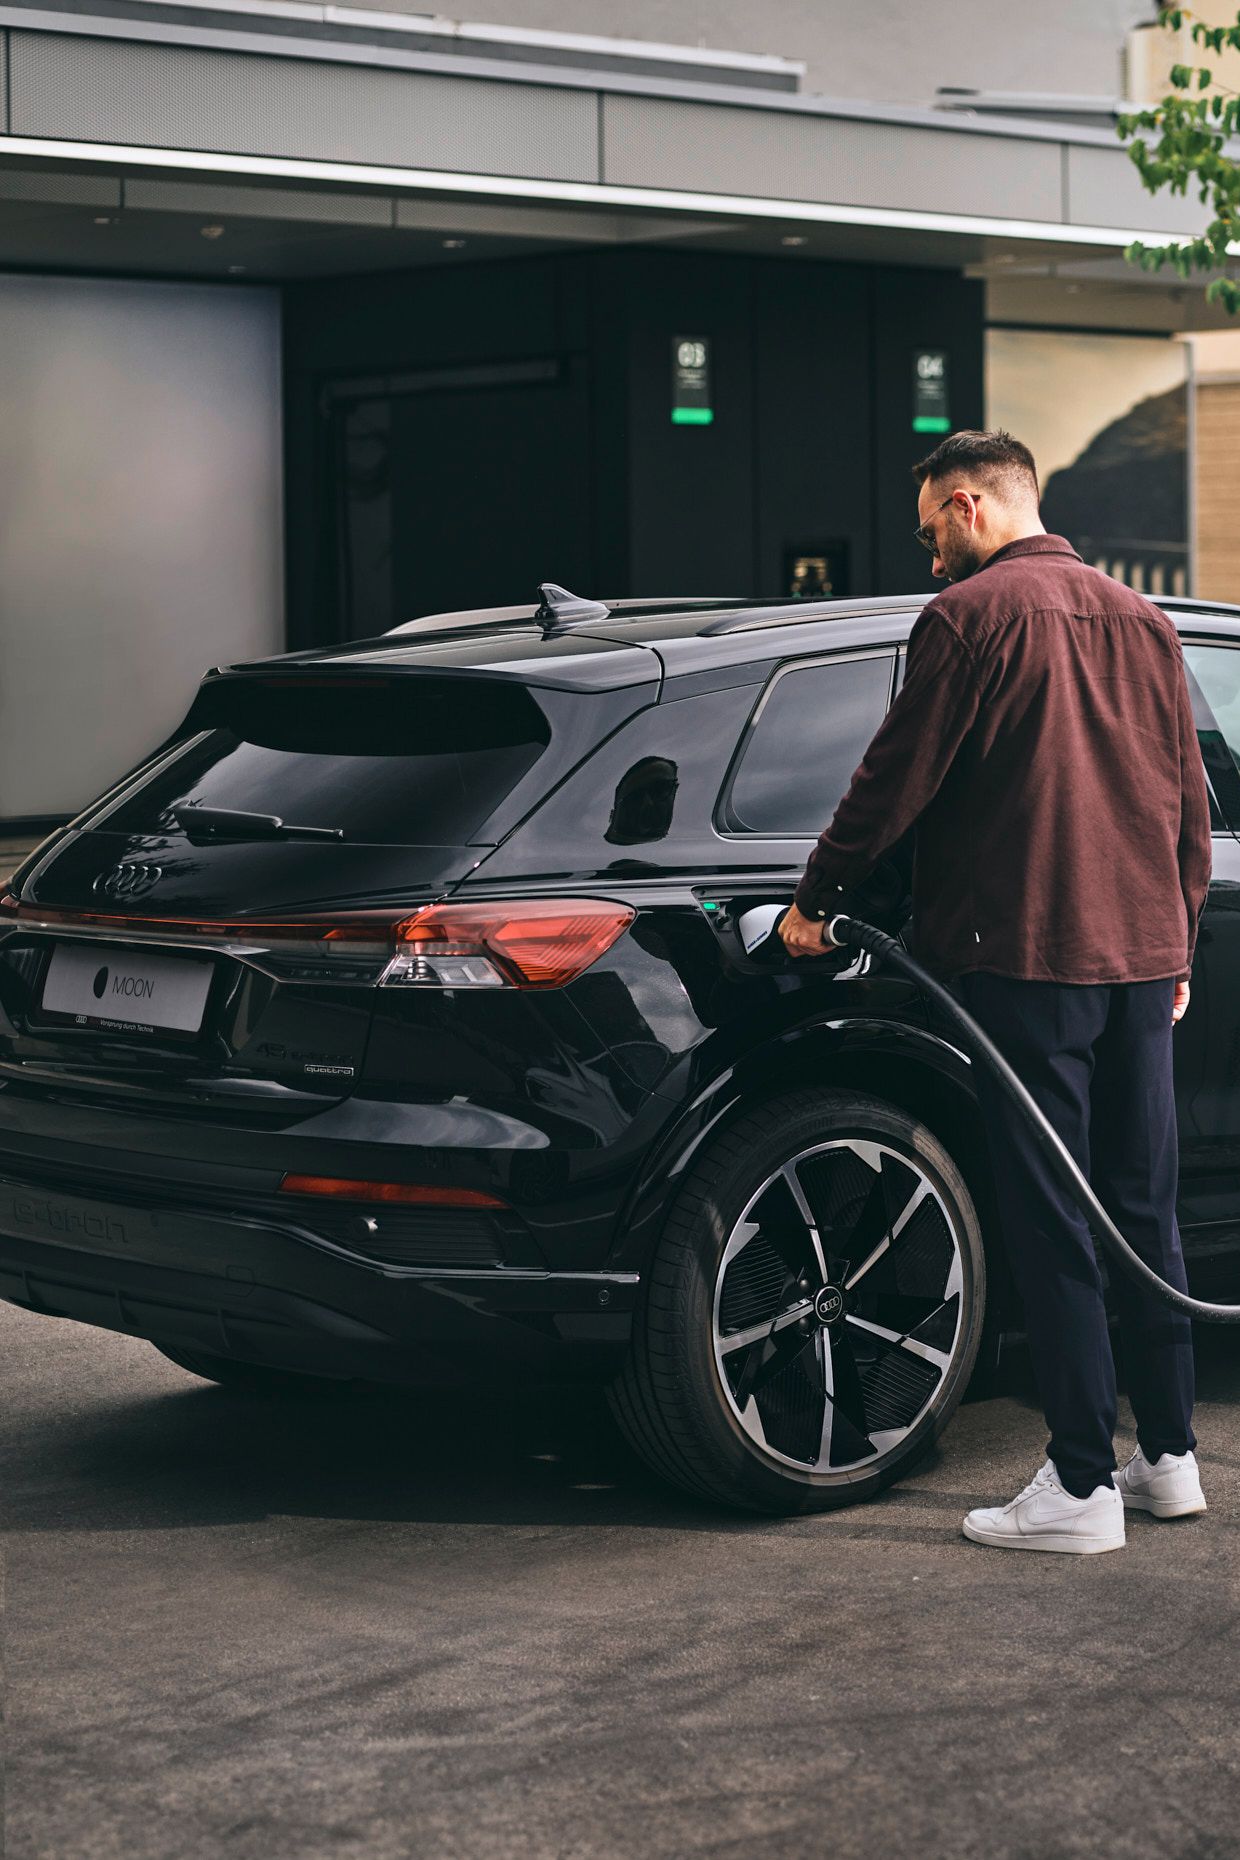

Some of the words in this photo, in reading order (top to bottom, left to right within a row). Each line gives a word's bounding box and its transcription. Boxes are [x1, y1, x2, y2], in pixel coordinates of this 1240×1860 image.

[678, 342, 706, 368] 03
[917, 355, 944, 378] 04
[112, 975, 155, 999] MOON
[100, 1018, 123, 1031] Vorsprung
[305, 1065, 352, 1076] quattro
